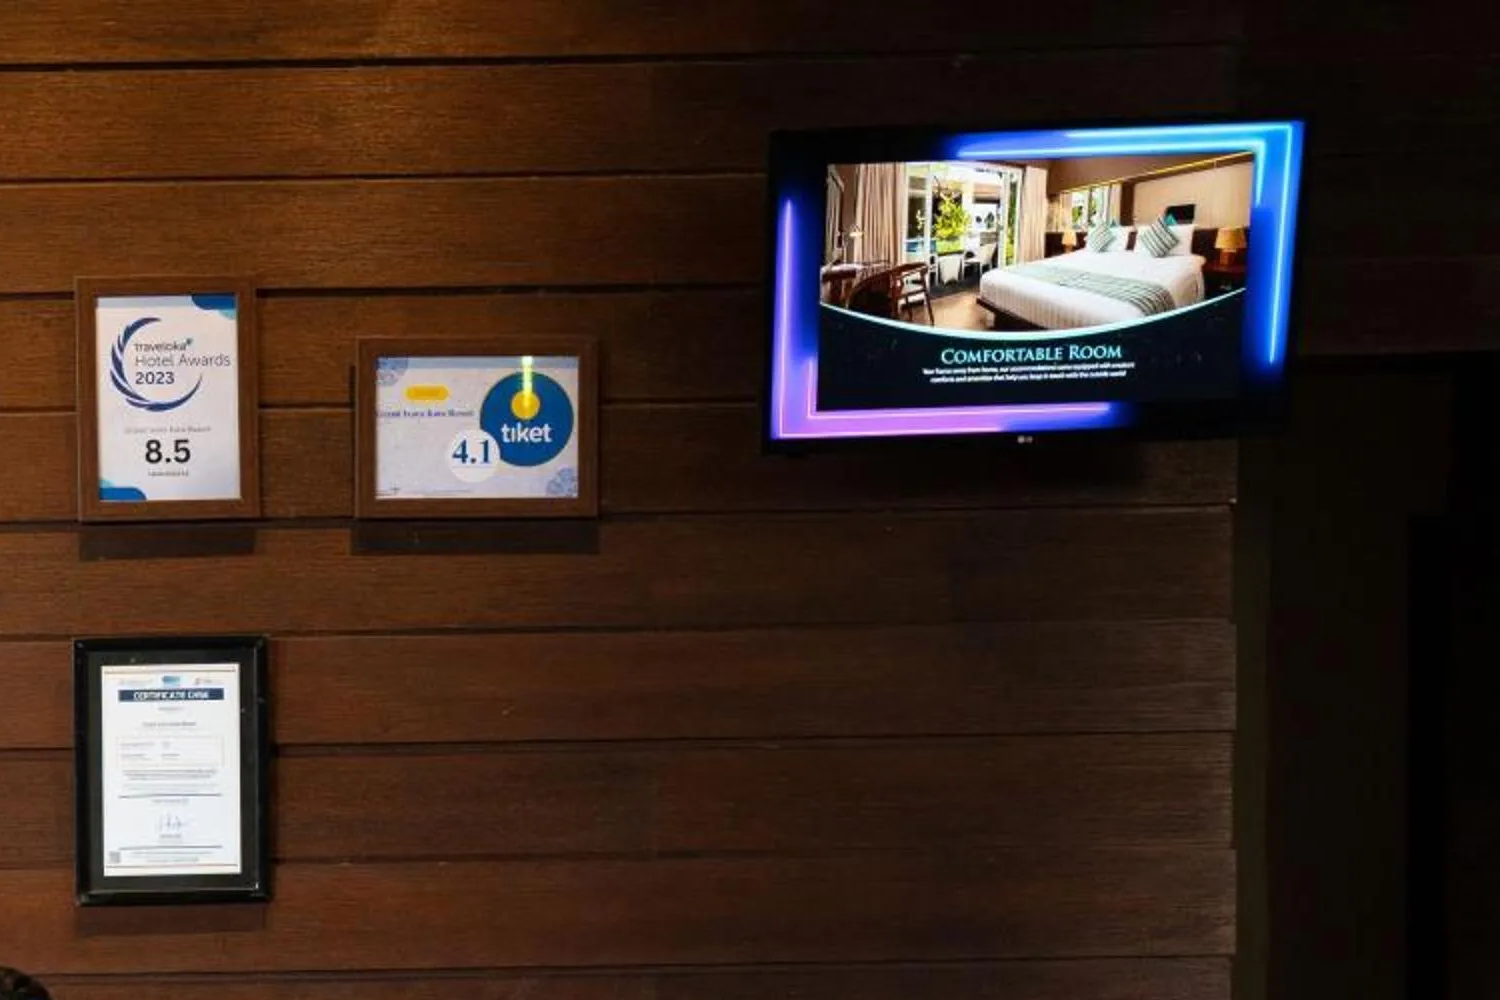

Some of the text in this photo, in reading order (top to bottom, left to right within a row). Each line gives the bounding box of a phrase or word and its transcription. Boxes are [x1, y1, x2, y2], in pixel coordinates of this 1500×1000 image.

[135, 353, 231, 367] Hotel Awards
[941, 344, 1123, 365] COMFORTABLE ROOM
[135, 371, 175, 385] 2023
[501, 422, 553, 443] tiket
[145, 439, 191, 464] 8.5
[452, 439, 492, 465] 4.1
